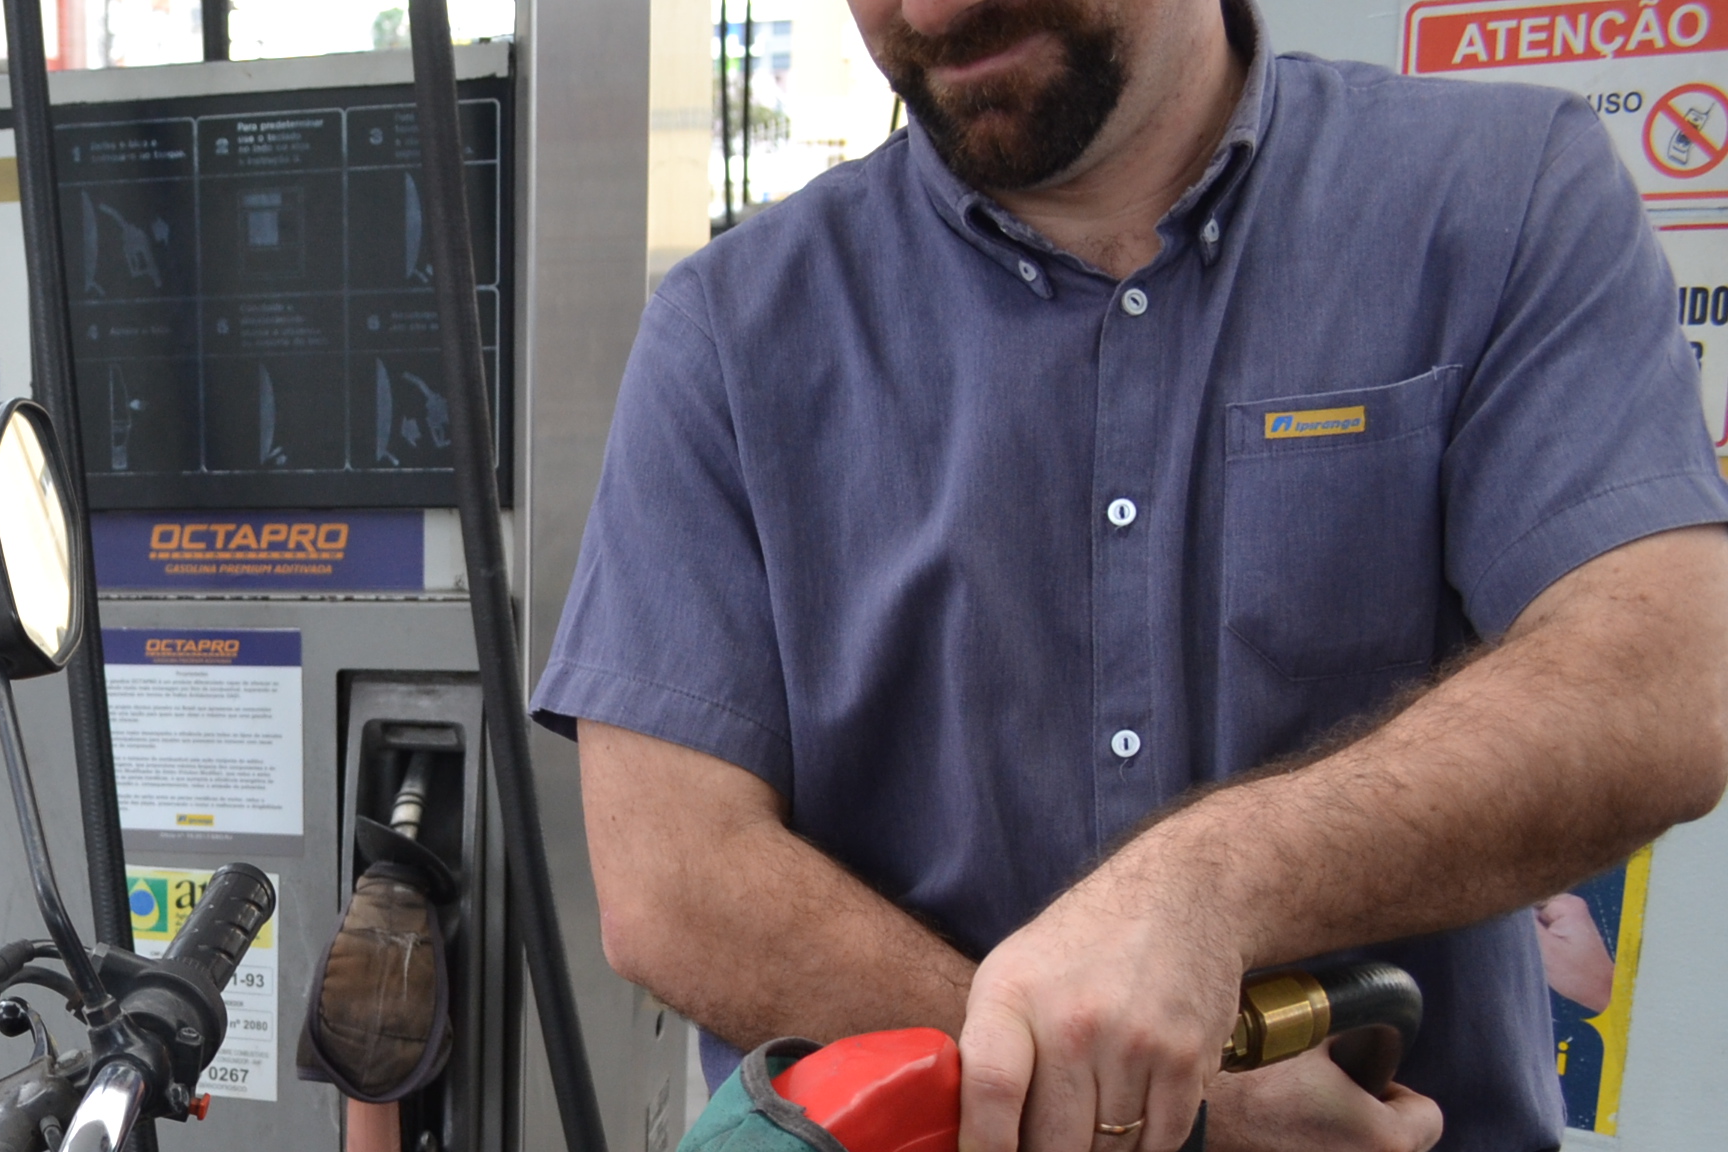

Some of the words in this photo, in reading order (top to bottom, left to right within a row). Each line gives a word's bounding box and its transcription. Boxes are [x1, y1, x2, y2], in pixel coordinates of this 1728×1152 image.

[1451, 0, 1710, 64] ATENÇÃO
[1678, 286, 1728, 326] IDO
[150, 523, 349, 551] OCTAPRO
[165, 563, 216, 574] GASOLINA
[219, 564, 272, 574] PREMIUM
[274, 564, 332, 574] ADITIVADA
[145, 638, 240, 652] OCTAPRO
[232, 972, 264, 988] 1-93
[244, 1020, 268, 1031] 2080
[208, 1066, 249, 1083] 0267
